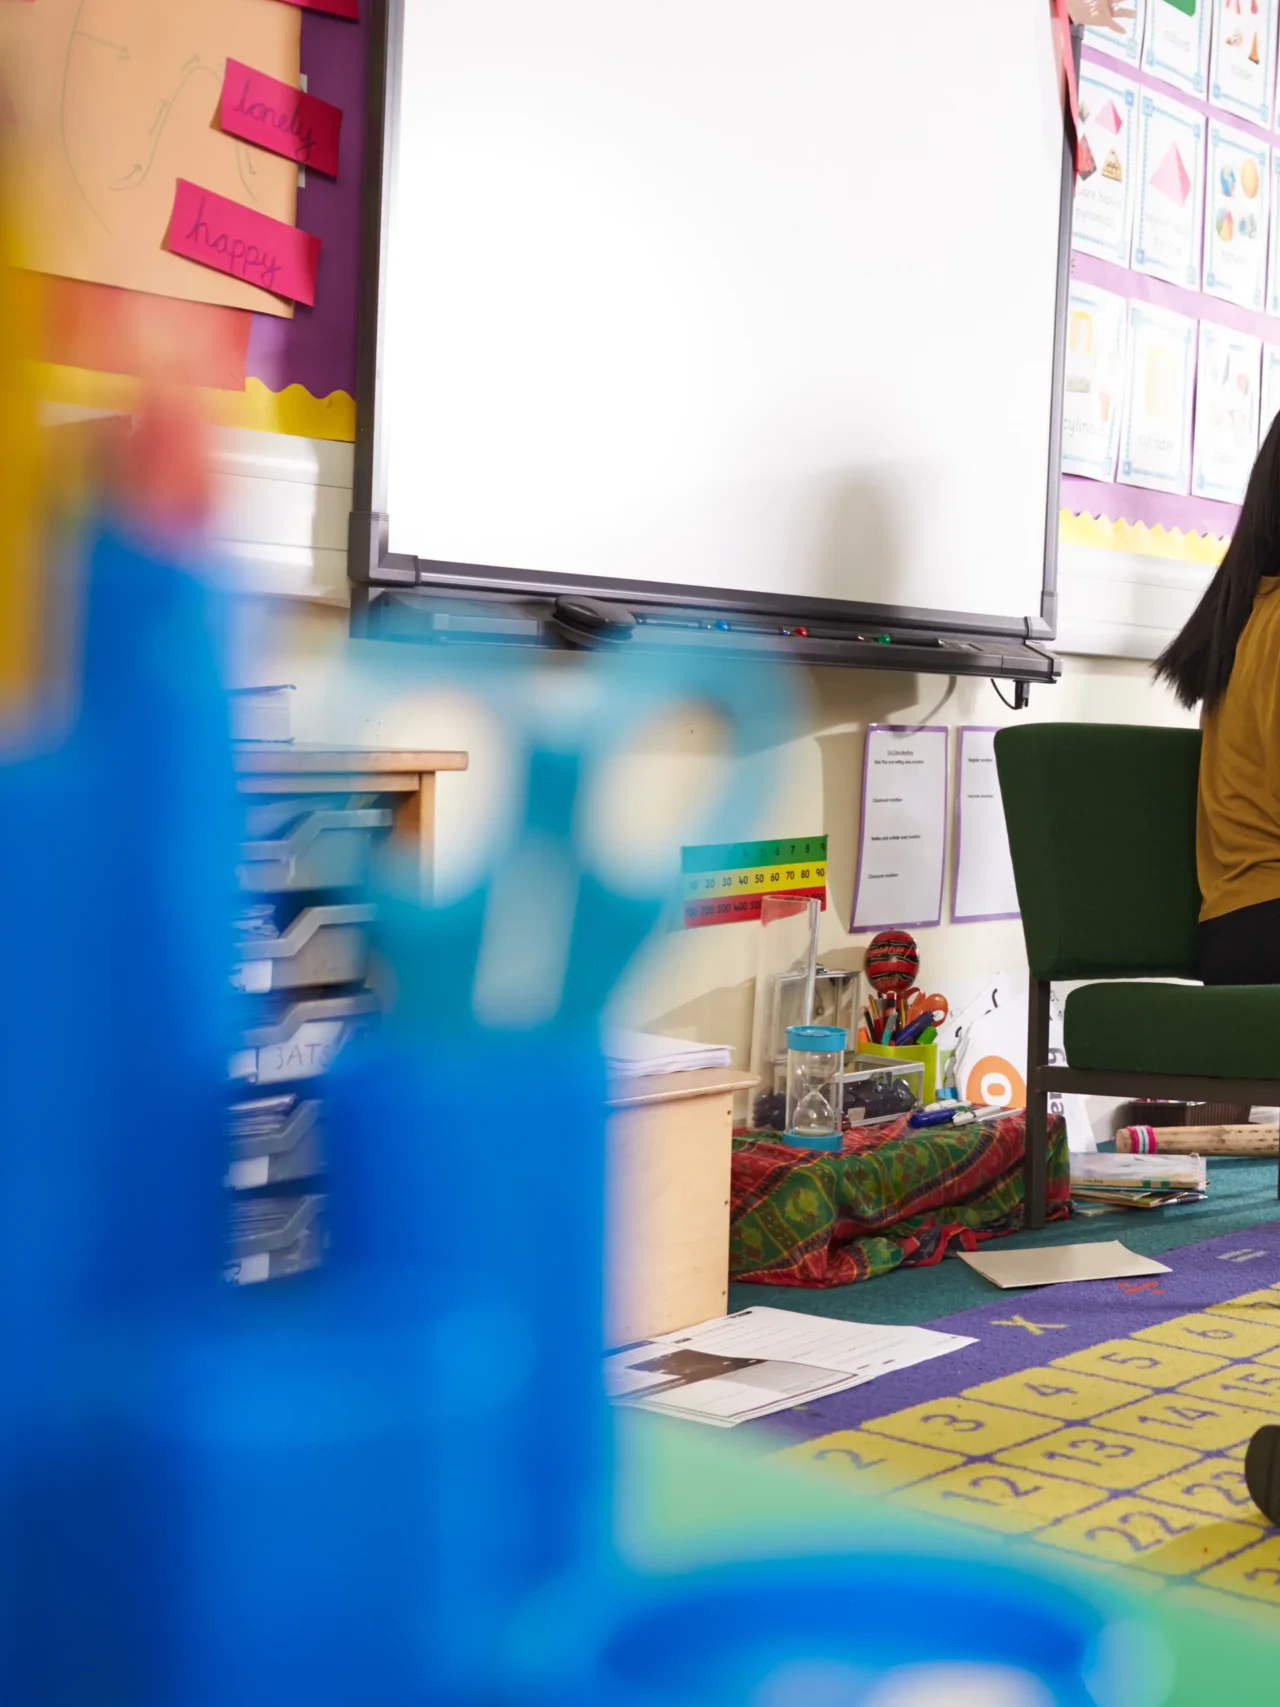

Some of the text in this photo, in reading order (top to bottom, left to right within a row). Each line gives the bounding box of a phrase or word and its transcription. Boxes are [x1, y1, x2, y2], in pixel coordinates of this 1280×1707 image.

[234, 77, 317, 160] lonely
[185, 194, 282, 289] happy
[774, 846, 781, 857] 6
[790, 844, 796, 855] 7
[804, 843, 811, 854] 8
[704, 878, 716, 889] 20
[721, 876, 732, 887] 30
[738, 875, 749, 886] 40
[754, 873, 765, 884] 50
[769, 872, 780, 883] 60
[785, 870, 796, 881] 70
[800, 868, 811, 879] 80
[815, 867, 826, 878] 90
[1100, 1352, 1162, 1370] 5
[920, 1413, 986, 1433] 3
[1138, 1405, 1221, 1430] 14
[1041, 1439, 1135, 1467] 13
[940, 1475, 1044, 1507] 12
[1084, 1511, 1197, 1552] 22
